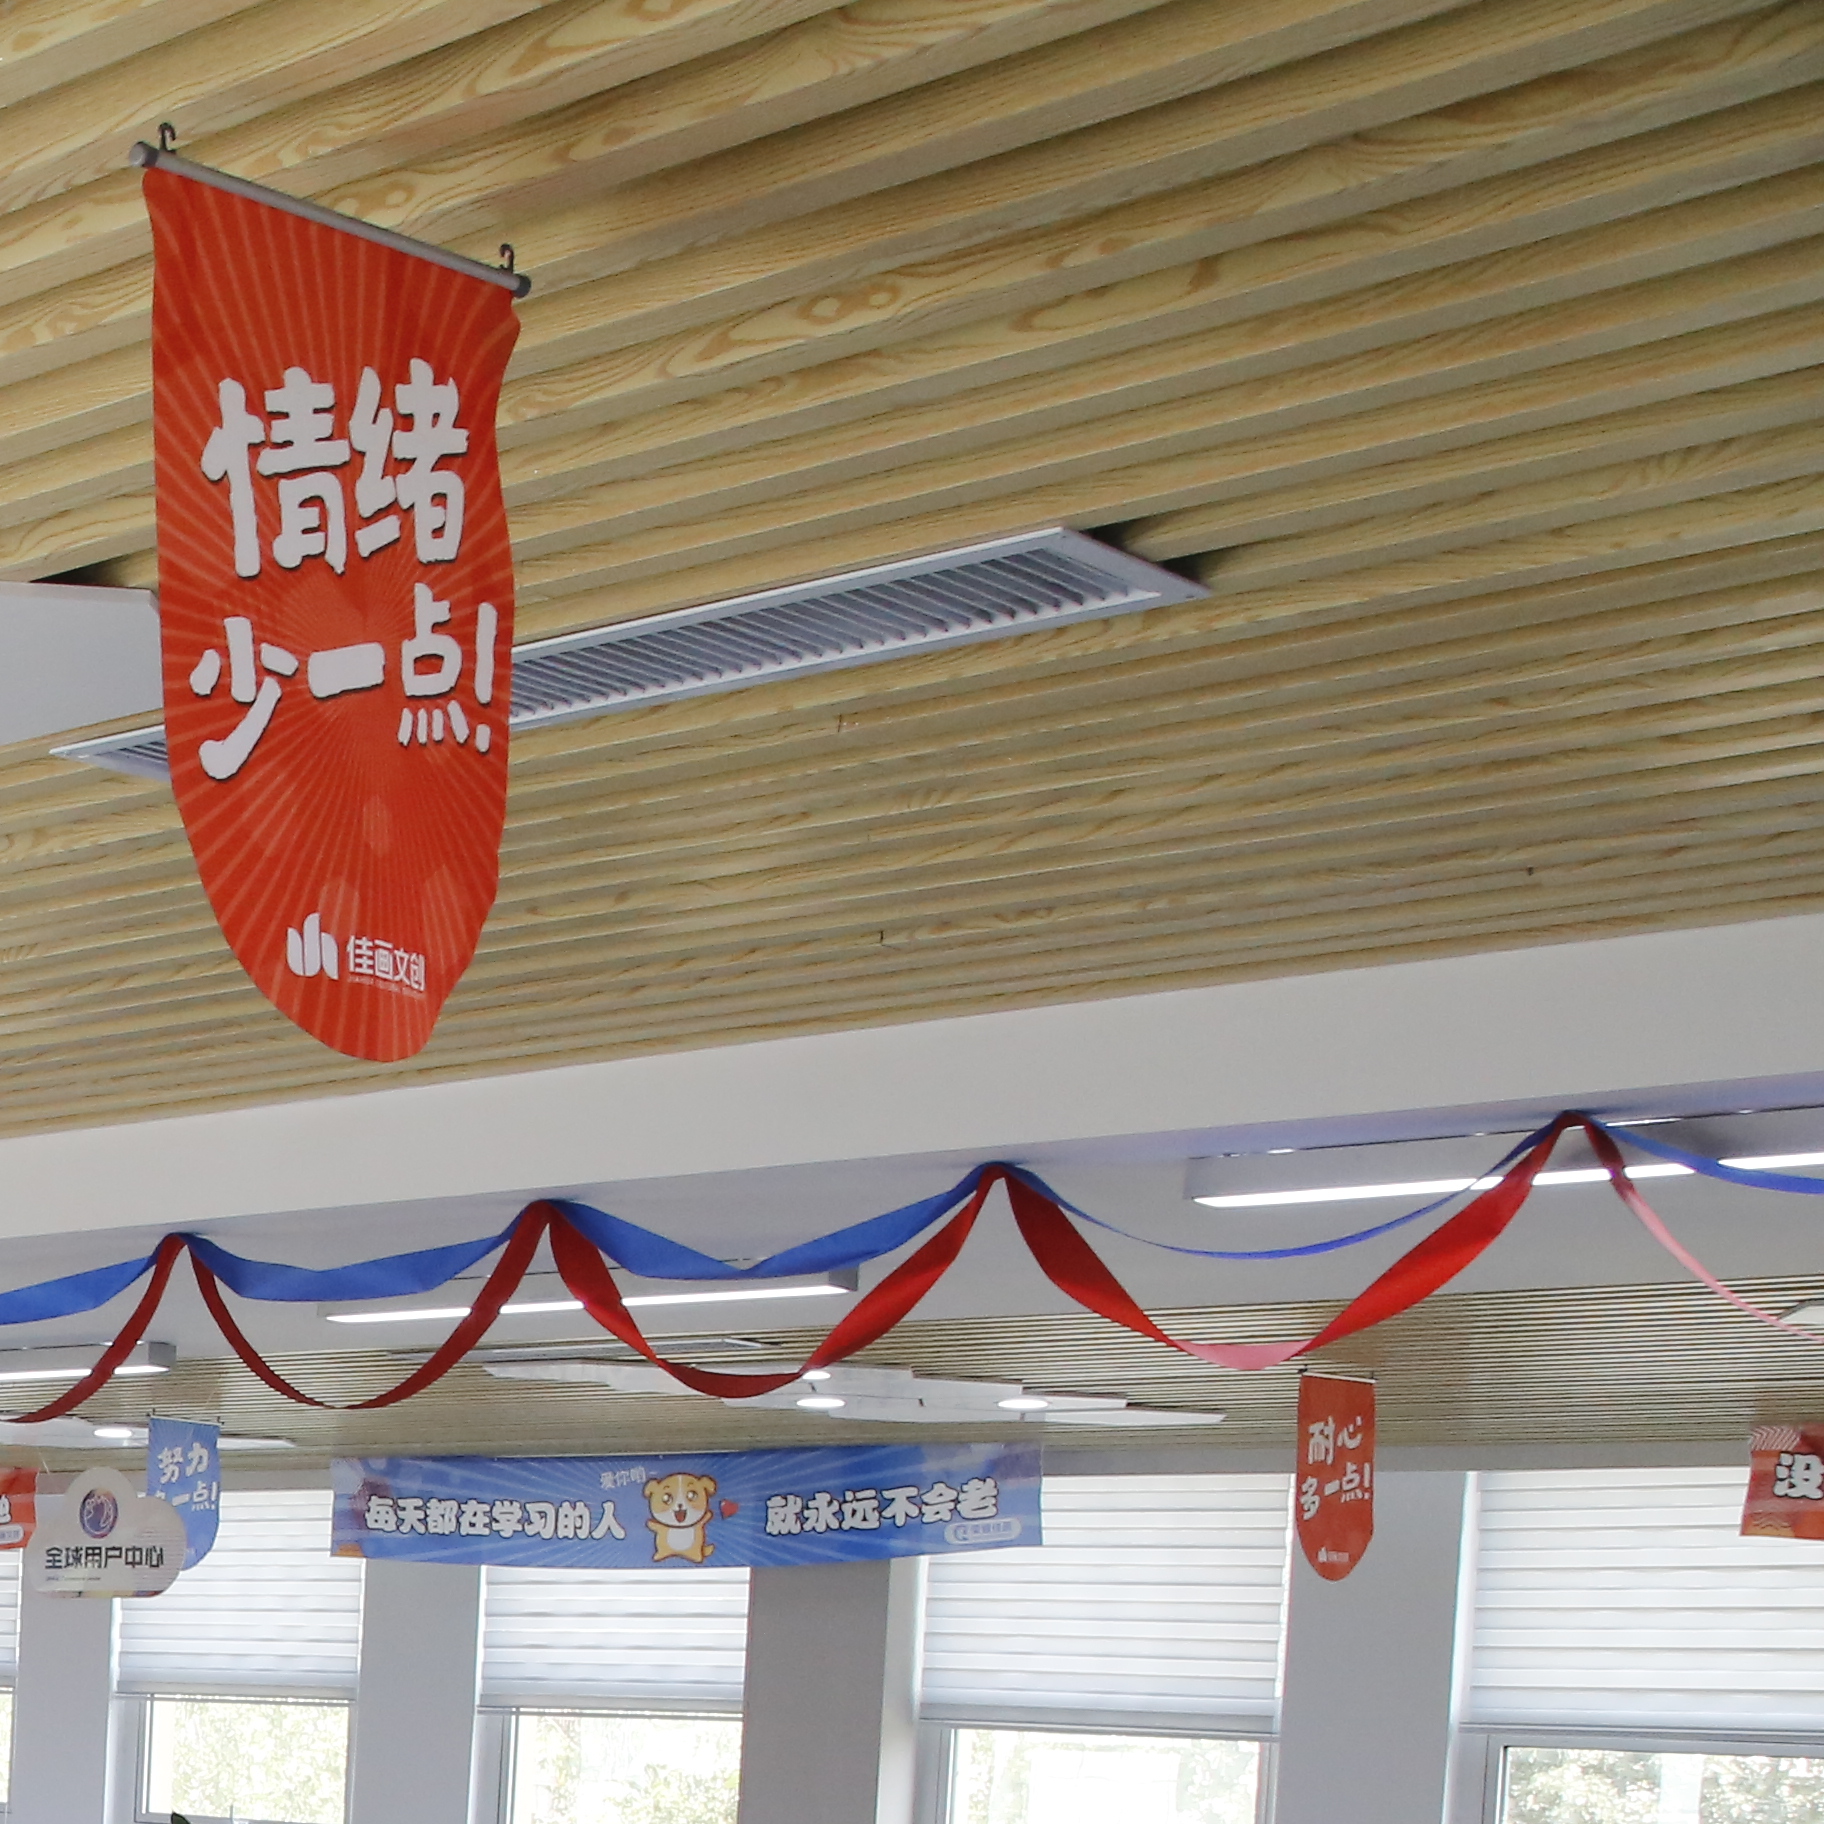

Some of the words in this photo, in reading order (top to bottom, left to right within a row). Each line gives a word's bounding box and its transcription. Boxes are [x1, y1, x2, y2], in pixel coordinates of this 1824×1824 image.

[201, 356, 469, 578] 情绪
[188, 582, 499, 781] 少一点!
[157, 1442, 209, 1484] 努力
[1308, 1415, 1364, 1466] 耐心
[364, 1494, 627, 1540] 每天都在学习的人
[764, 1476, 1000, 1537] 就永远不会老
[1300, 1462, 1371, 1520] 多一点!
[44, 1545, 164, 1571] 全球用户中心
